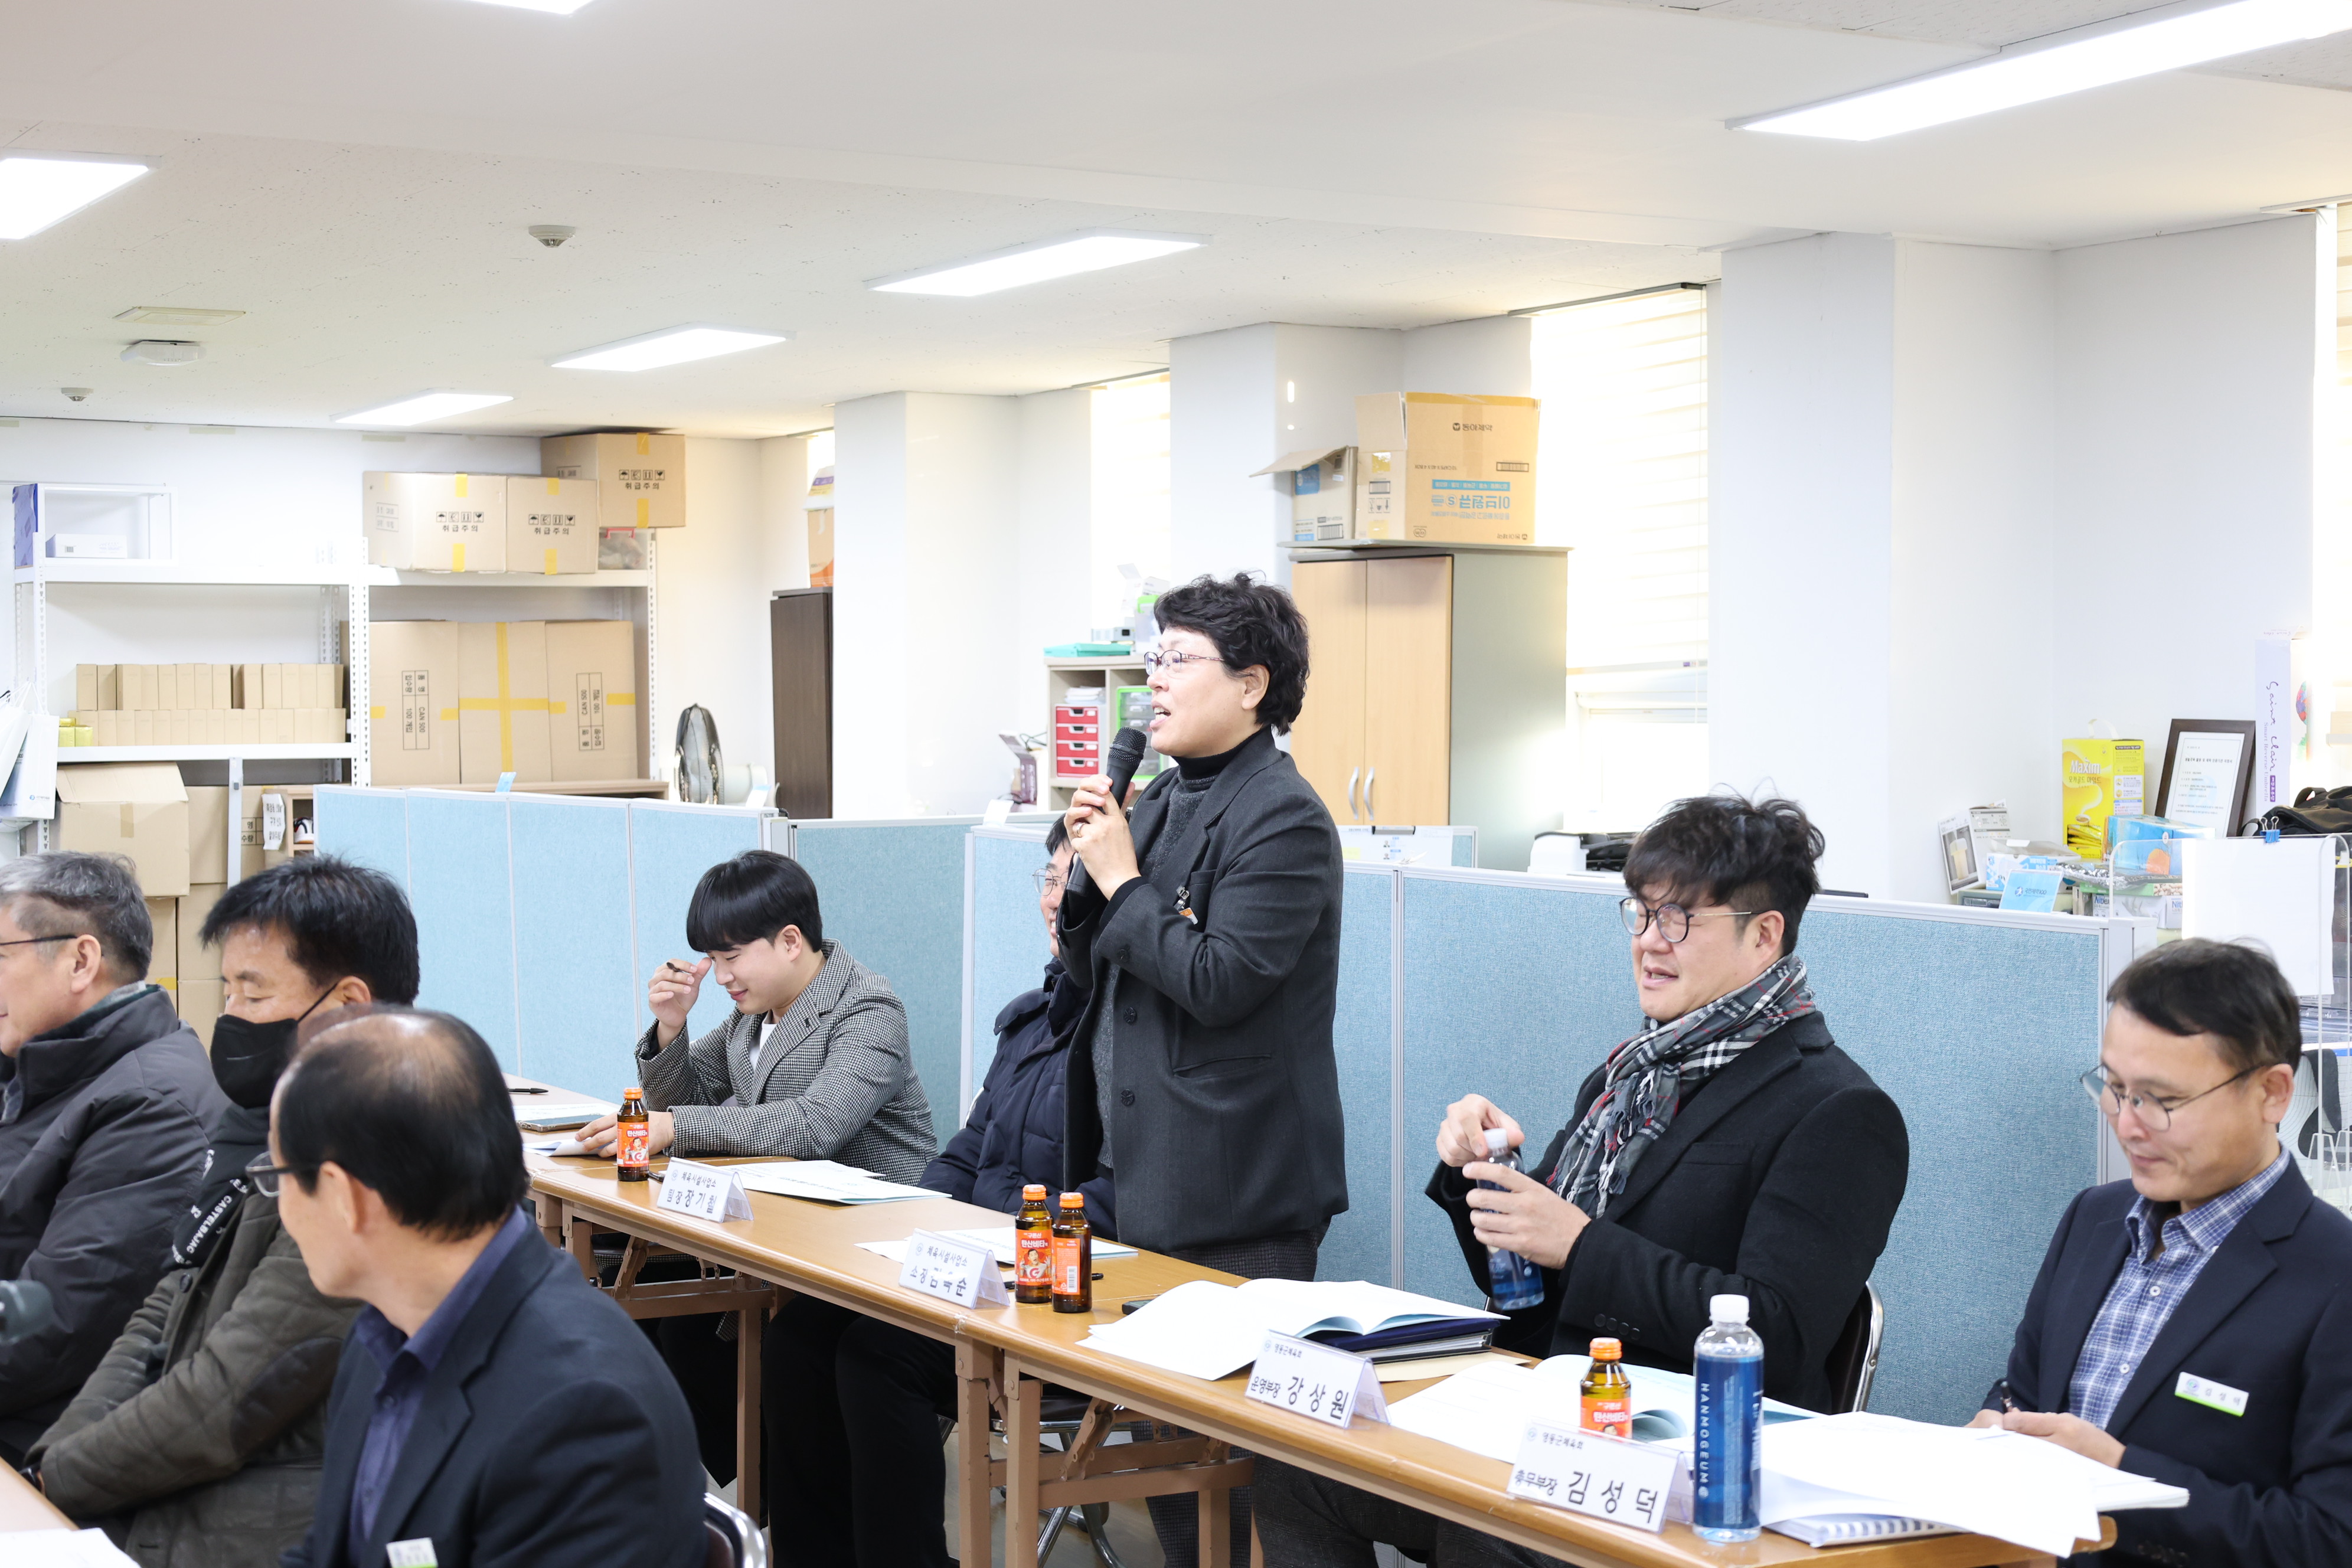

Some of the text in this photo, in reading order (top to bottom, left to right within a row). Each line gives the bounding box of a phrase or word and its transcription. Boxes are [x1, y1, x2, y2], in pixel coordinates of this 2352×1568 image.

[1462, 423, 1493, 432] 동아제약
[625, 482, 660, 490] 취급주의
[1459, 495, 1510, 509] 이브원큐
[534, 527, 570, 535] 취급주의
[2070, 760, 2101, 774] Maxim
[681, 1171, 717, 1188] 체육시설사업소
[186, 1195, 233, 1255] CASTELBAJAC
[927, 1246, 968, 1267] 체육시설사업소
[1274, 1343, 1302, 1358] 영동군체육회
[1250, 1376, 1349, 1420] 운영부장 강상원
[1542, 1432, 1583, 1451] 영동군체육회
[1700, 1382, 1710, 1486] HANMOGEUM
[1514, 1469, 1659, 1524] 총무부장 김성덕
